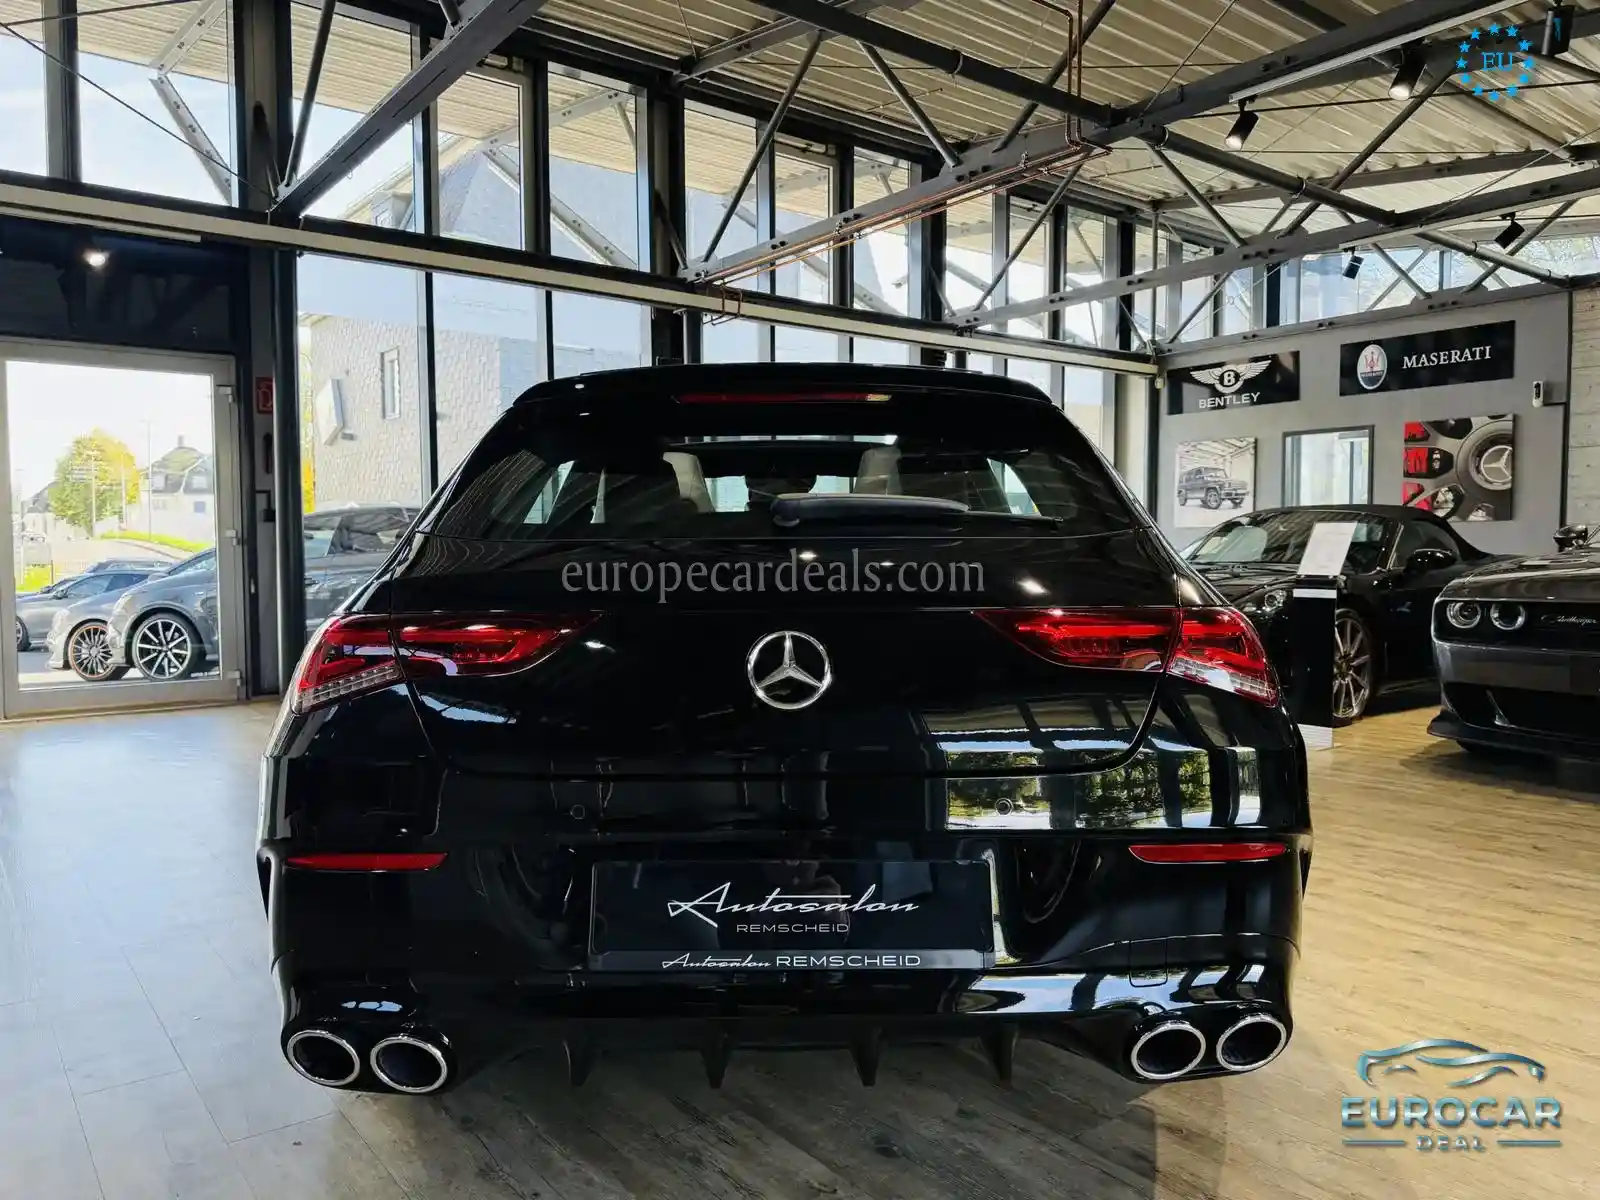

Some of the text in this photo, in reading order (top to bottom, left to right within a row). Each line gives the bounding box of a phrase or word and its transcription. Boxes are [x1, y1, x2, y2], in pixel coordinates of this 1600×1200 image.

[1402, 345, 1492, 369] MASERATI
[1199, 392, 1260, 409] BENTLEY
[667, 882, 919, 928] Autosalon
[736, 923, 849, 933] REMSCHEID
[662, 952, 922, 969] Autosalon REMSCHEID
